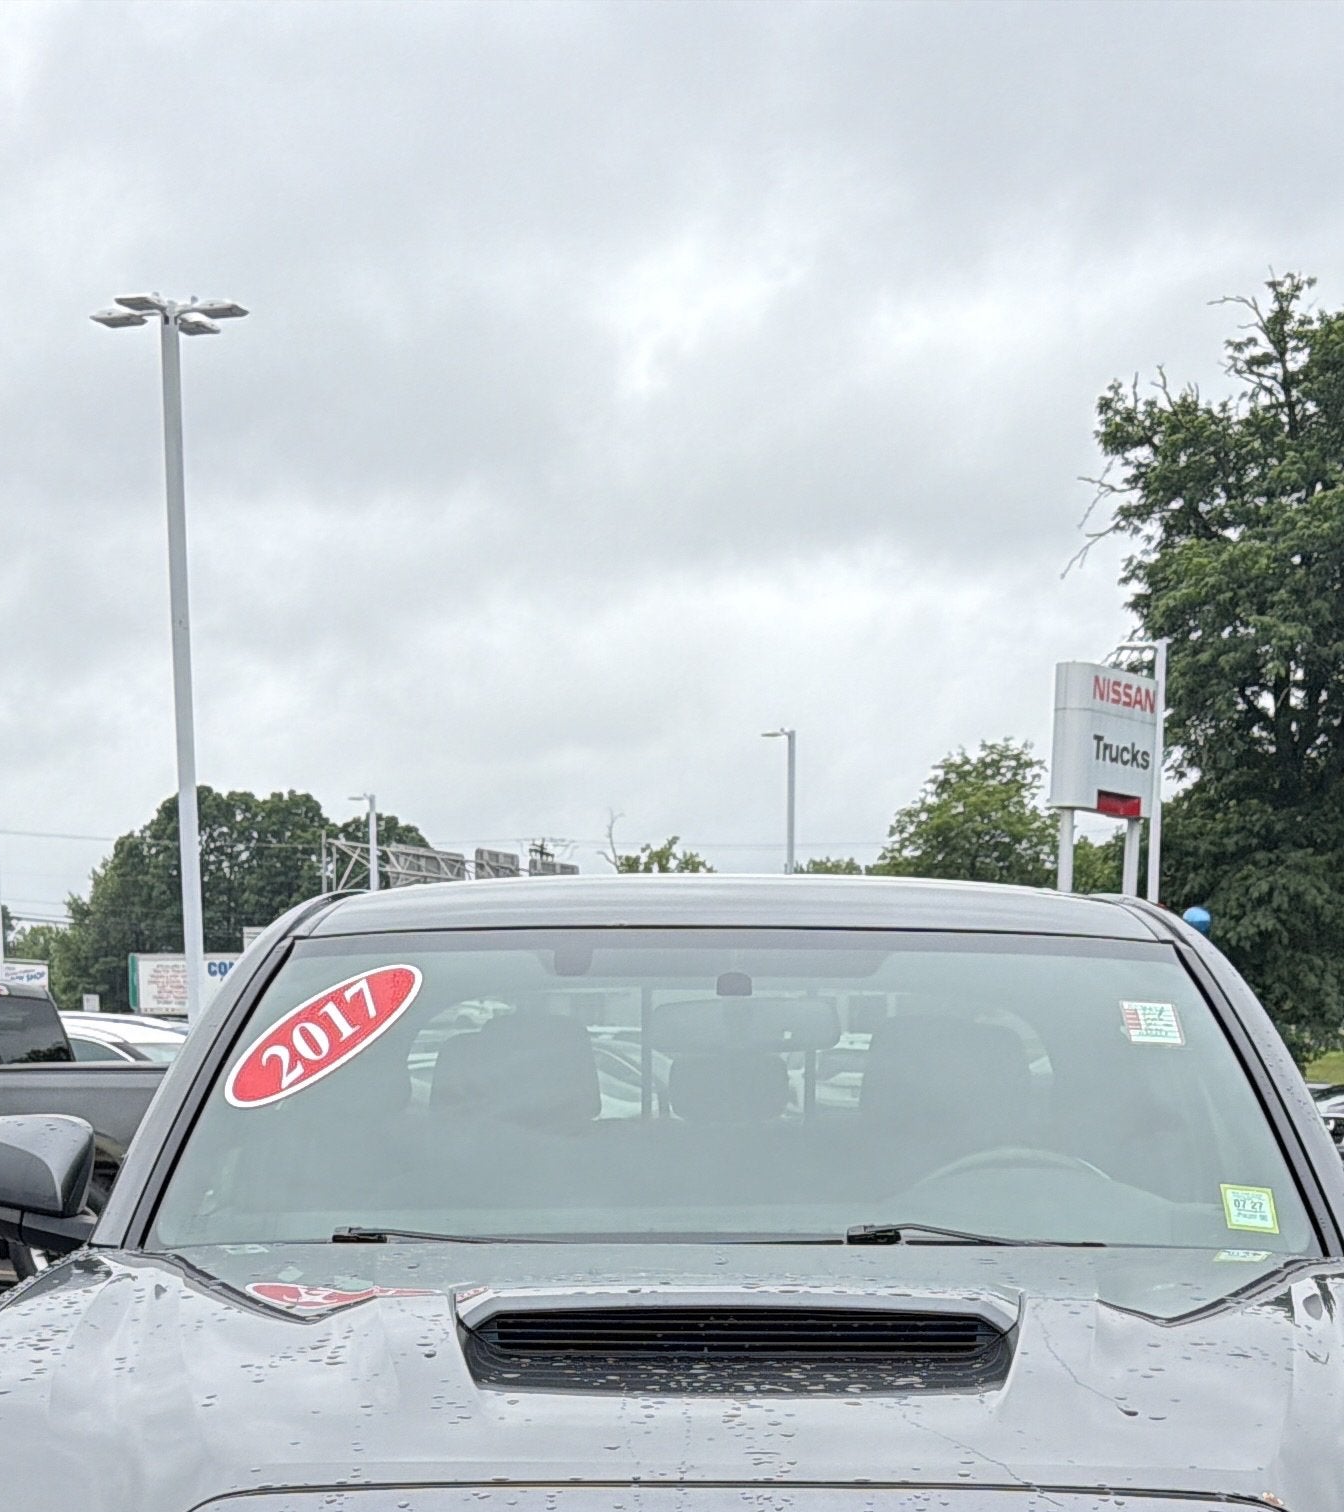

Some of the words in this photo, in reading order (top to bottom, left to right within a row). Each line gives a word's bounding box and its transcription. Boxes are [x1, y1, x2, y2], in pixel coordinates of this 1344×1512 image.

[1093, 675, 1156, 714] NISSAN
[1093, 734, 1150, 770] Trucks
[261, 978, 378, 1090] 2017
